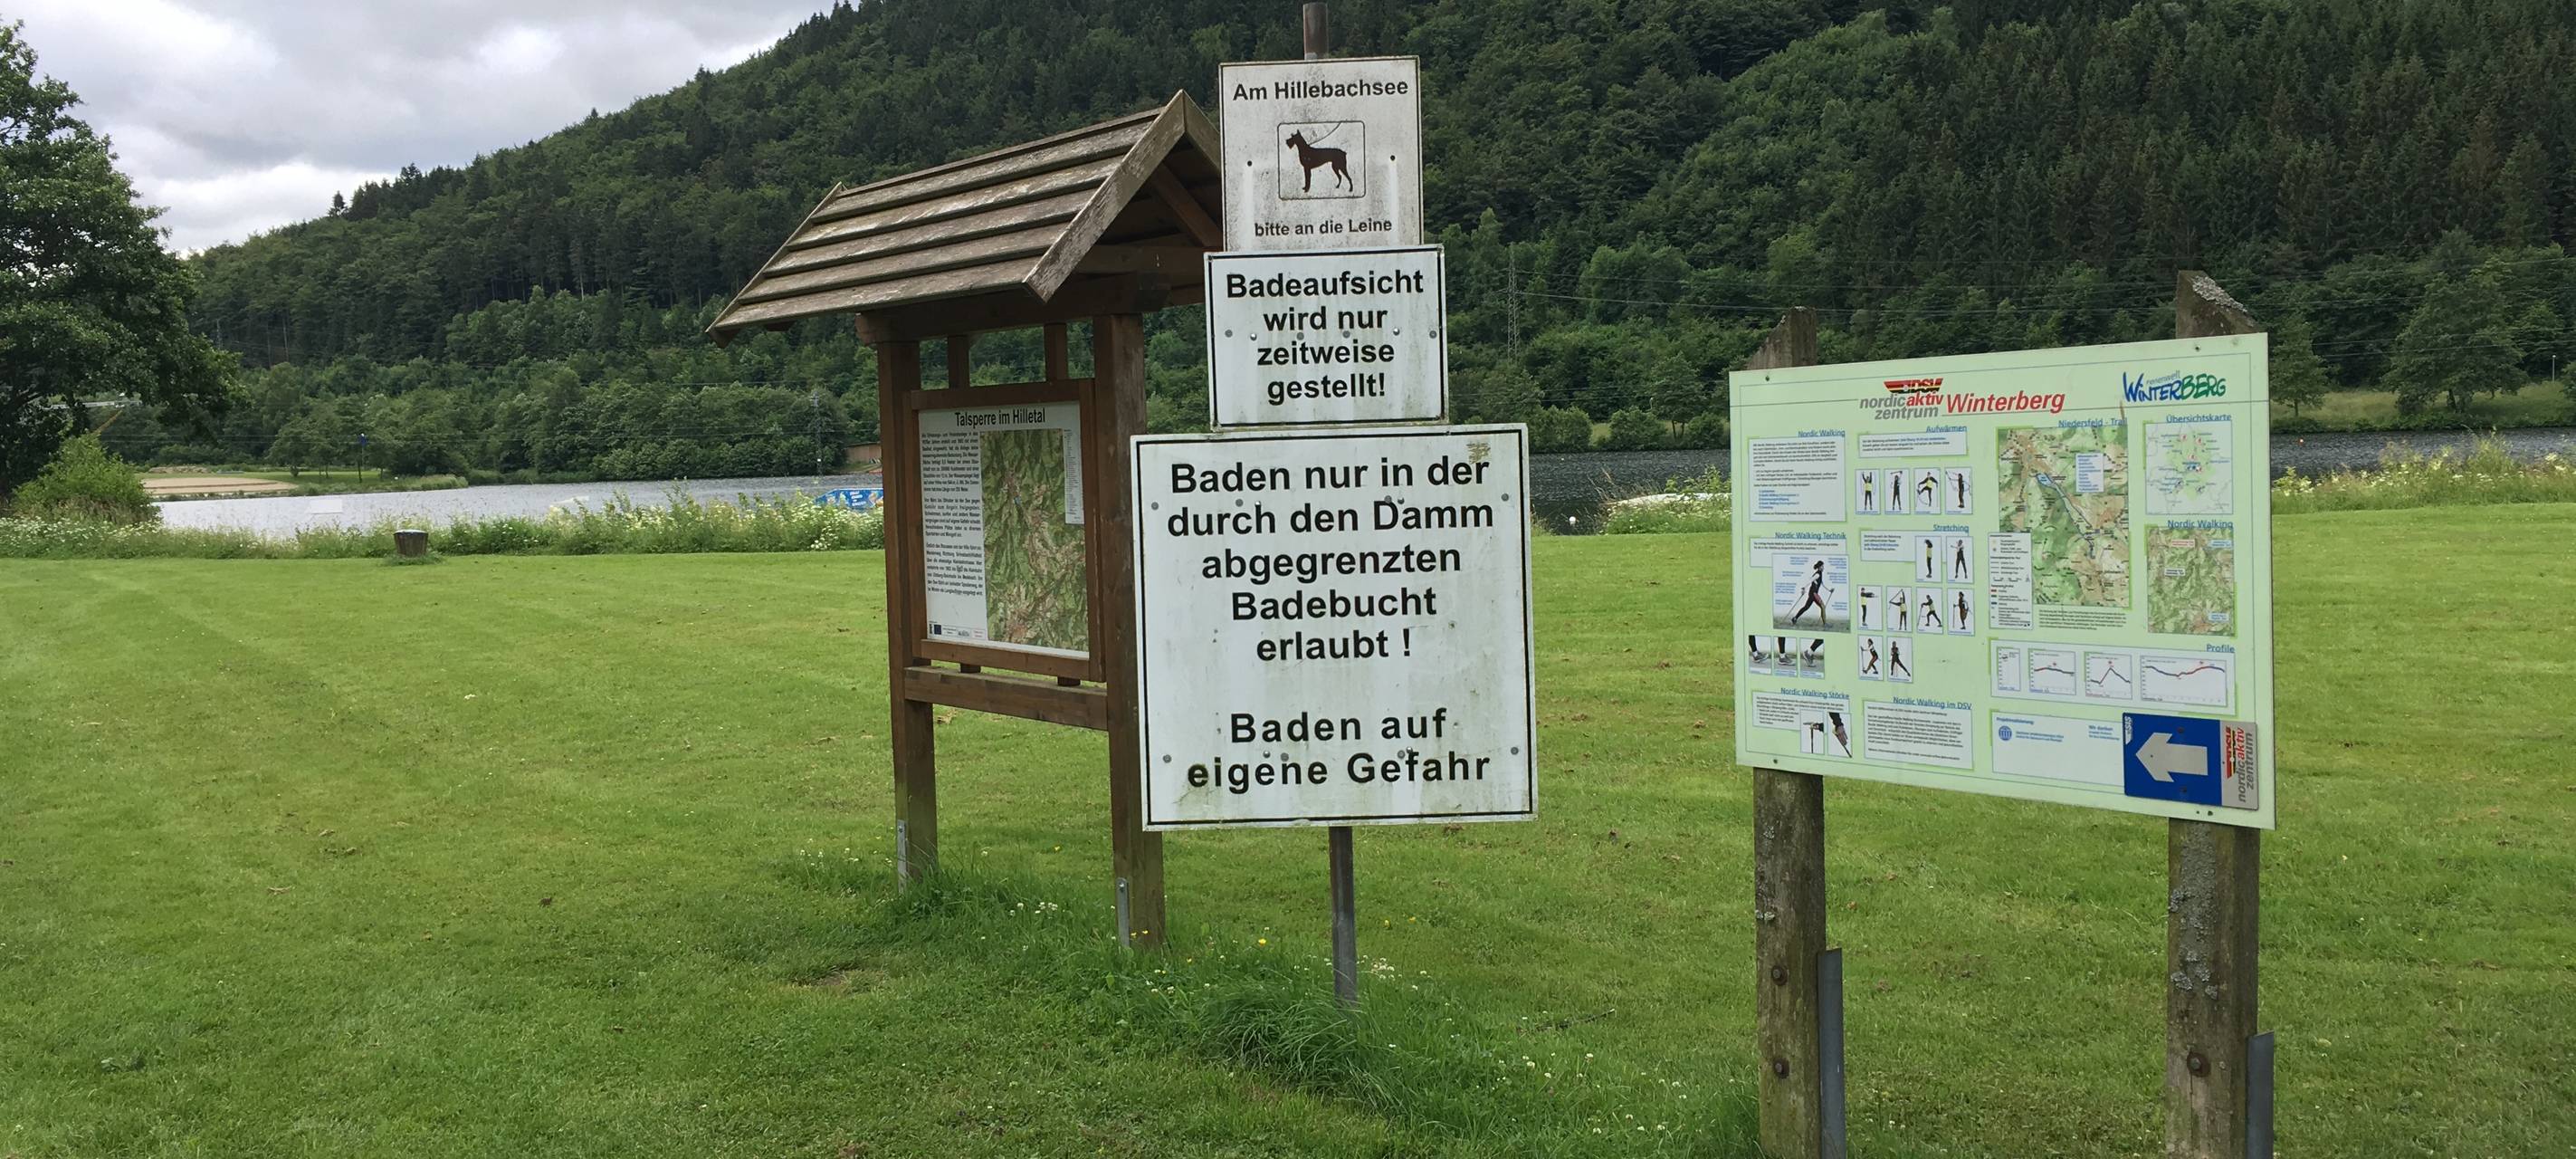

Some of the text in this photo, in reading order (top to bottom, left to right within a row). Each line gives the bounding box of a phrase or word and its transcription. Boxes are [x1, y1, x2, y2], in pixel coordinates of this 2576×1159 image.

[1233, 80, 1408, 101] Am Hillebachsee
[1255, 217, 1392, 237] bitte an die Leine
[1226, 270, 1424, 298] Badeaufsicht
[1264, 306, 1388, 331] wird nur
[1256, 339, 1395, 366] zeitweise
[1267, 372, 1385, 406] gestellt!
[1946, 390, 2066, 414] Winterberg
[955, 407, 1045, 429] Talsperre im Hilletal
[1875, 407, 1939, 421] zentrum
[2058, 419, 2103, 428] Niedersfeld
[2166, 413, 2232, 424] Übersichtskarte
[1798, 429, 1846, 438] Nordic Walking
[1926, 426, 1968, 434] Aufwärmen
[1170, 455, 1490, 493] Baden nur in der
[1168, 500, 1493, 537] durch den Damm
[1933, 524, 1970, 533] Stretching
[2168, 520, 2233, 530] Nordic Walking
[1775, 532, 1846, 541] Nordic Walking Technik
[1202, 544, 1461, 585] abgegrenzten
[1231, 587, 1436, 620] Badebucht
[1256, 629, 1389, 662] erlaubt
[2206, 644, 2235, 653] Profile
[1780, 687, 1800, 696] Nordic
[1801, 689, 1827, 699] Walking
[1893, 696, 1971, 710] Nordic Walking im DSV
[1230, 707, 1447, 743] Baden auf
[1188, 750, 1491, 794] eigene Gefahr
[2245, 733, 2254, 790] zentrum
